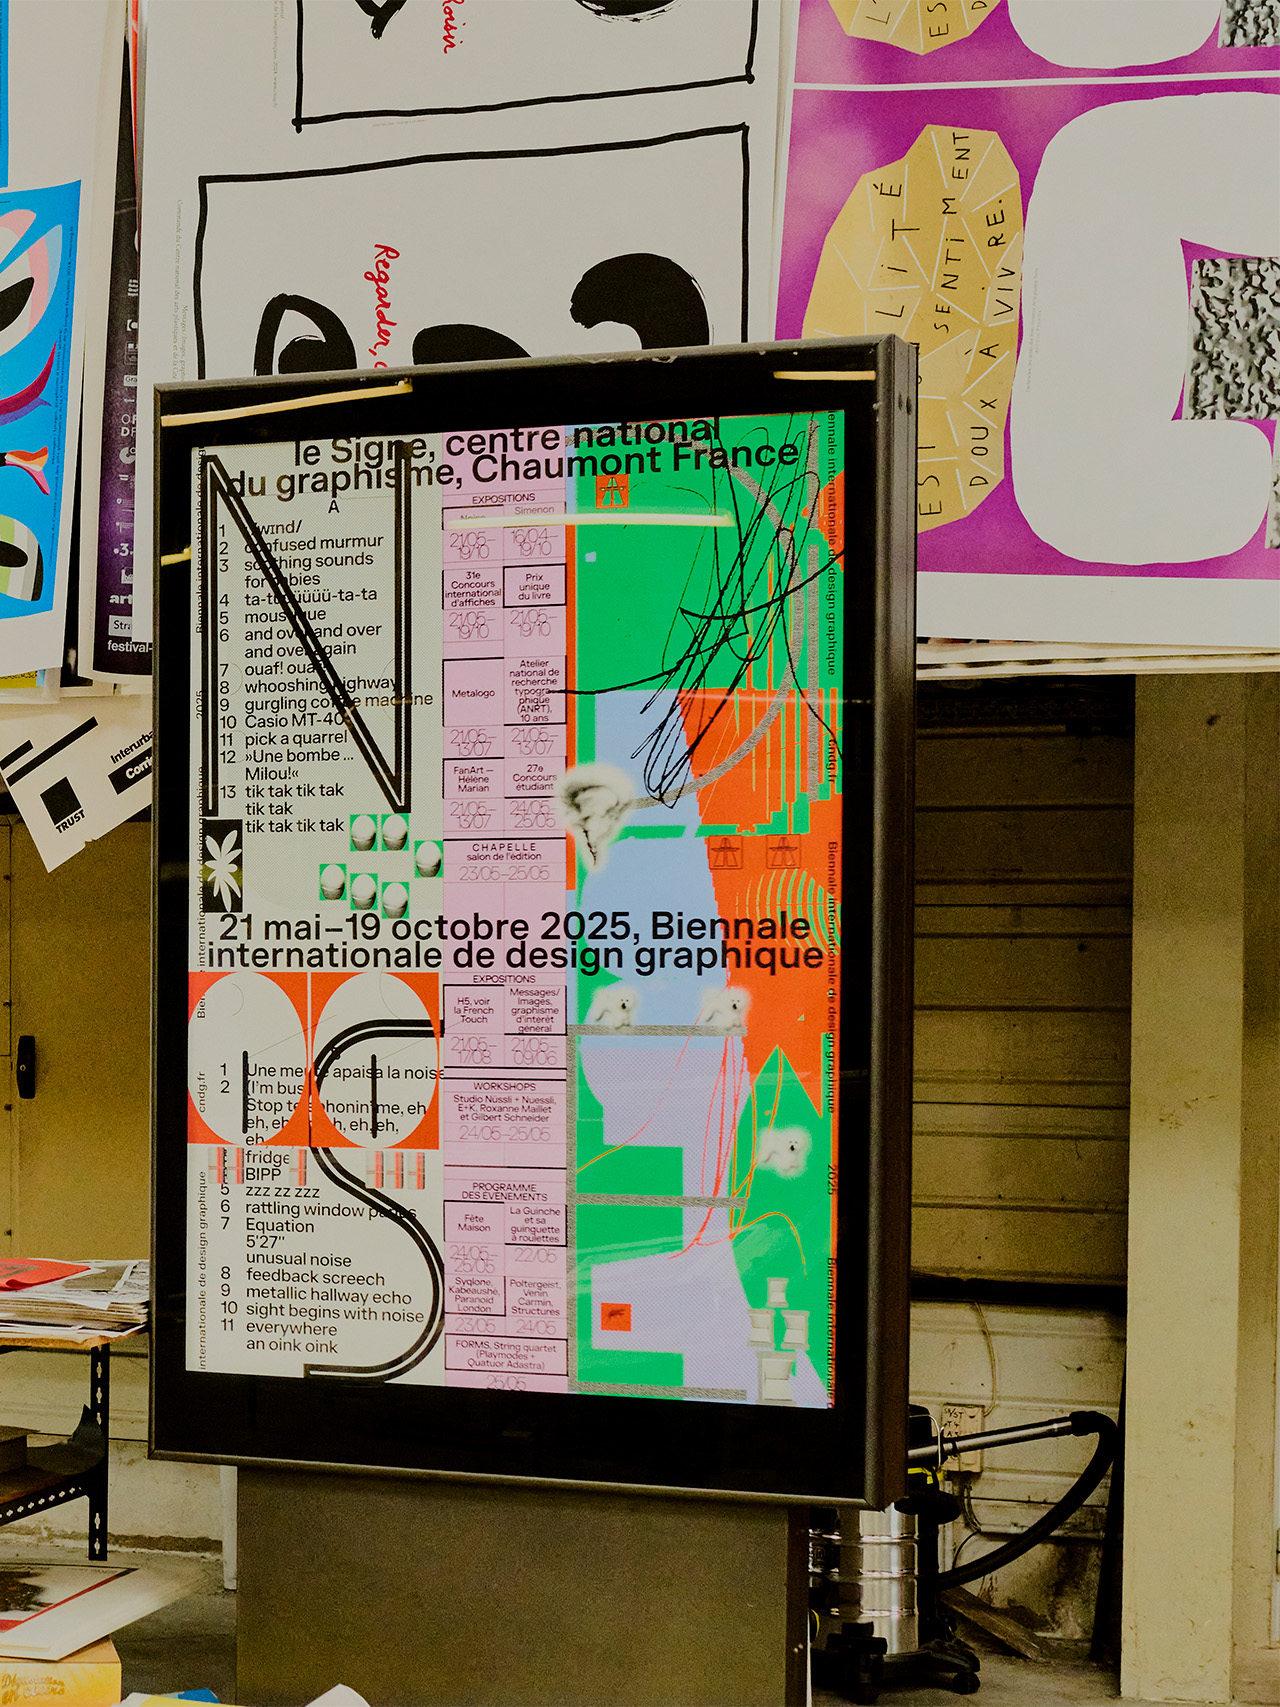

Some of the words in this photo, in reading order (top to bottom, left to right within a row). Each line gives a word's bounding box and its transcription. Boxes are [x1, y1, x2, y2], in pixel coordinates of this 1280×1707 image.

[440, 0, 466, 54] oisir
[363, 243, 401, 357] Regarder,
[295, 441, 321, 466] le
[445, 427, 561, 458] centre
[574, 416, 721, 450] national
[969, 398, 1000, 487] DOUX
[229, 470, 266, 499] du
[276, 459, 462, 502] graphisme,
[472, 444, 661, 484] Chaumont
[673, 442, 800, 472] France
[472, 493, 536, 504] EXPOSITIONS
[827, 458, 837, 546] internationale
[328, 500, 341, 514] A
[320, 536, 384, 550] murmur
[315, 552, 374, 567] sounds
[466, 571, 481, 580] 31e
[525, 573, 544, 583] Prix
[451, 580, 496, 590] Concours
[519, 582, 551, 594] unique
[825, 567, 837, 609] design
[445, 588, 502, 599] international
[519, 591, 531, 601] du
[532, 590, 552, 600] livre
[451, 596, 496, 607] d'affiches
[245, 627, 273, 642] and
[346, 625, 382, 638] over
[245, 644, 273, 659] and
[824, 613, 836, 676] graphique
[245, 661, 283, 676] ouaf!
[520, 659, 549, 668] Atelier
[509, 668, 546, 677] national
[548, 668, 560, 677] de
[511, 678, 558, 686] recherche
[451, 688, 496, 699] Metalogo
[245, 696, 307, 715] gurgling
[220, 715, 238, 729] 10
[245, 714, 288, 729] Casio
[220, 733, 234, 747] 11
[245, 732, 277, 749] pick
[280, 735, 290, 746] a
[293, 730, 348, 749] quarrel
[220, 750, 237, 764] 12
[286, 748, 340, 762] bombe
[454, 766, 484, 775] FanArt
[526, 764, 544, 773] 27e
[512, 773, 558, 782] Concours
[220, 785, 237, 799] 13
[245, 783, 265, 798] tik
[268, 783, 293, 798] tak
[297, 783, 316, 797] tik
[319, 782, 345, 796] tak
[458, 784, 490, 793] Marian
[245, 802, 265, 816] tik
[268, 801, 293, 815] tak
[56, 809, 86, 834] TRUST
[245, 819, 265, 834] tik
[268, 819, 294, 833] tak
[297, 819, 317, 833] tik
[320, 818, 345, 832] tak
[472, 843, 537, 852] CHAPELLE
[466, 852, 492, 861] salon
[493, 852, 505, 861] de
[220, 913, 253, 941] 21
[392, 912, 529, 941] octobre
[541, 911, 640, 945] 2025,
[651, 911, 811, 940] Biennale
[208, 941, 442, 969] internationale
[453, 941, 495, 969] de
[505, 941, 624, 976] design
[635, 940, 825, 976] graphique
[463, 1006, 494, 1015] French
[460, 1015, 488, 1024] Touch
[247, 1063, 277, 1077] Une
[387, 1065, 401, 1079] la
[473, 1082, 536, 1092] WORKSHOPS
[247, 1098, 284, 1114] Stop
[504, 1114, 550, 1123] Schneider
[245, 1168, 282, 1182] BIPP
[827, 1164, 838, 1196] 2025
[246, 1186, 270, 1198] zzz
[274, 1187, 291, 1198] zz
[295, 1188, 320, 1199] zzz
[473, 1183, 537, 1193] PROGRAMME
[198, 1170, 208, 1230] graphique
[245, 1203, 300, 1218] rattling
[304, 1204, 365, 1218] window
[523, 1207, 561, 1217] Guinche
[246, 1219, 315, 1237] Equation
[458, 1223, 491, 1233] Maison
[198, 1232, 208, 1270] design
[246, 1253, 307, 1266] unusual
[310, 1254, 352, 1268] noise
[198, 1273, 206, 1288] de
[246, 1268, 319, 1284] feedback
[322, 1271, 386, 1286] screech
[246, 1286, 308, 1301] metallic
[310, 1288, 370, 1306] hallway
[372, 1292, 412, 1305] echo
[220, 1302, 238, 1315] 10
[246, 1303, 286, 1319] sight
[289, 1304, 341, 1321] begins
[344, 1306, 378, 1321] with
[381, 1310, 425, 1324] noise
[511, 1306, 561, 1317] Structures
[198, 1290, 207, 1370] internationale
[220, 1319, 235, 1332] 11
[246, 1321, 338, 1337] everywhere
[246, 1339, 265, 1351] an
[268, 1337, 303, 1352] oink
[305, 1339, 338, 1354] oink
